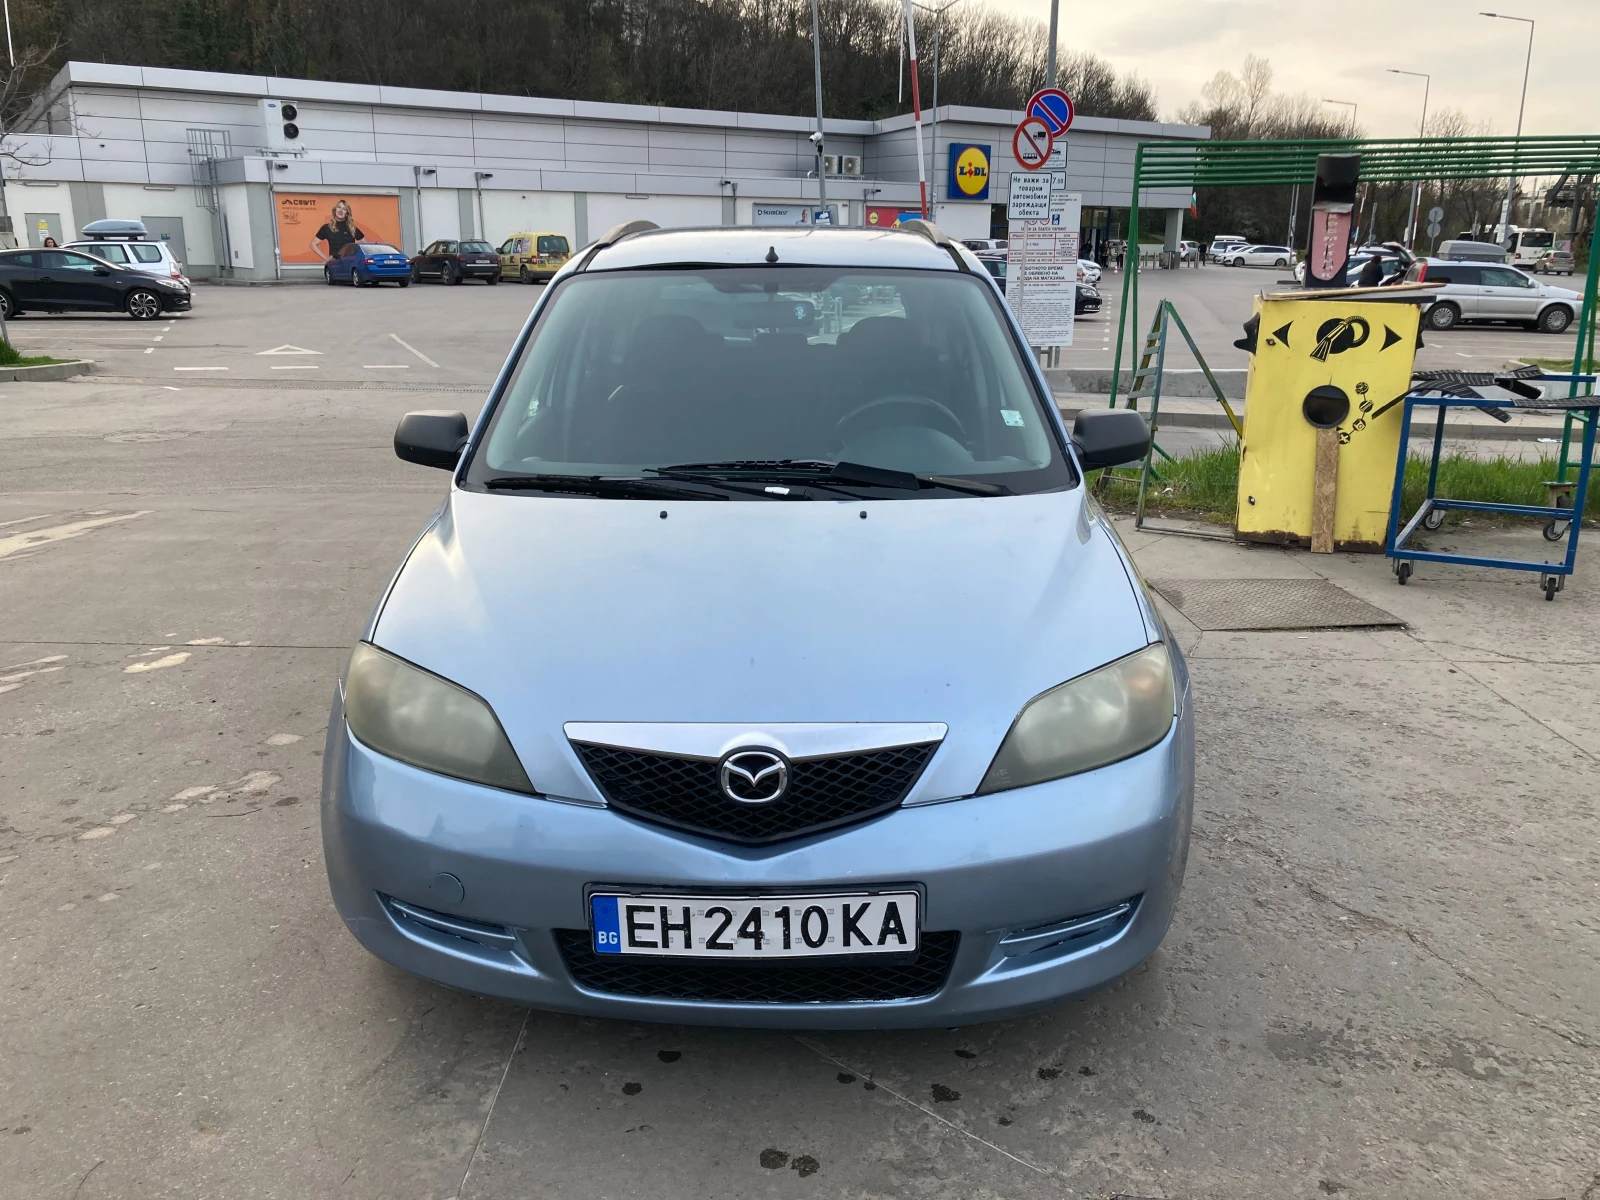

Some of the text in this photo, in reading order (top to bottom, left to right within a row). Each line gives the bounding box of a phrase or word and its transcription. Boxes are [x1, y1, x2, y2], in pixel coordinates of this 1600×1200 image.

[958, 162, 987, 178] LIDL
[1013, 192, 1048, 200] автомобили
[597, 930, 618, 945] BG
